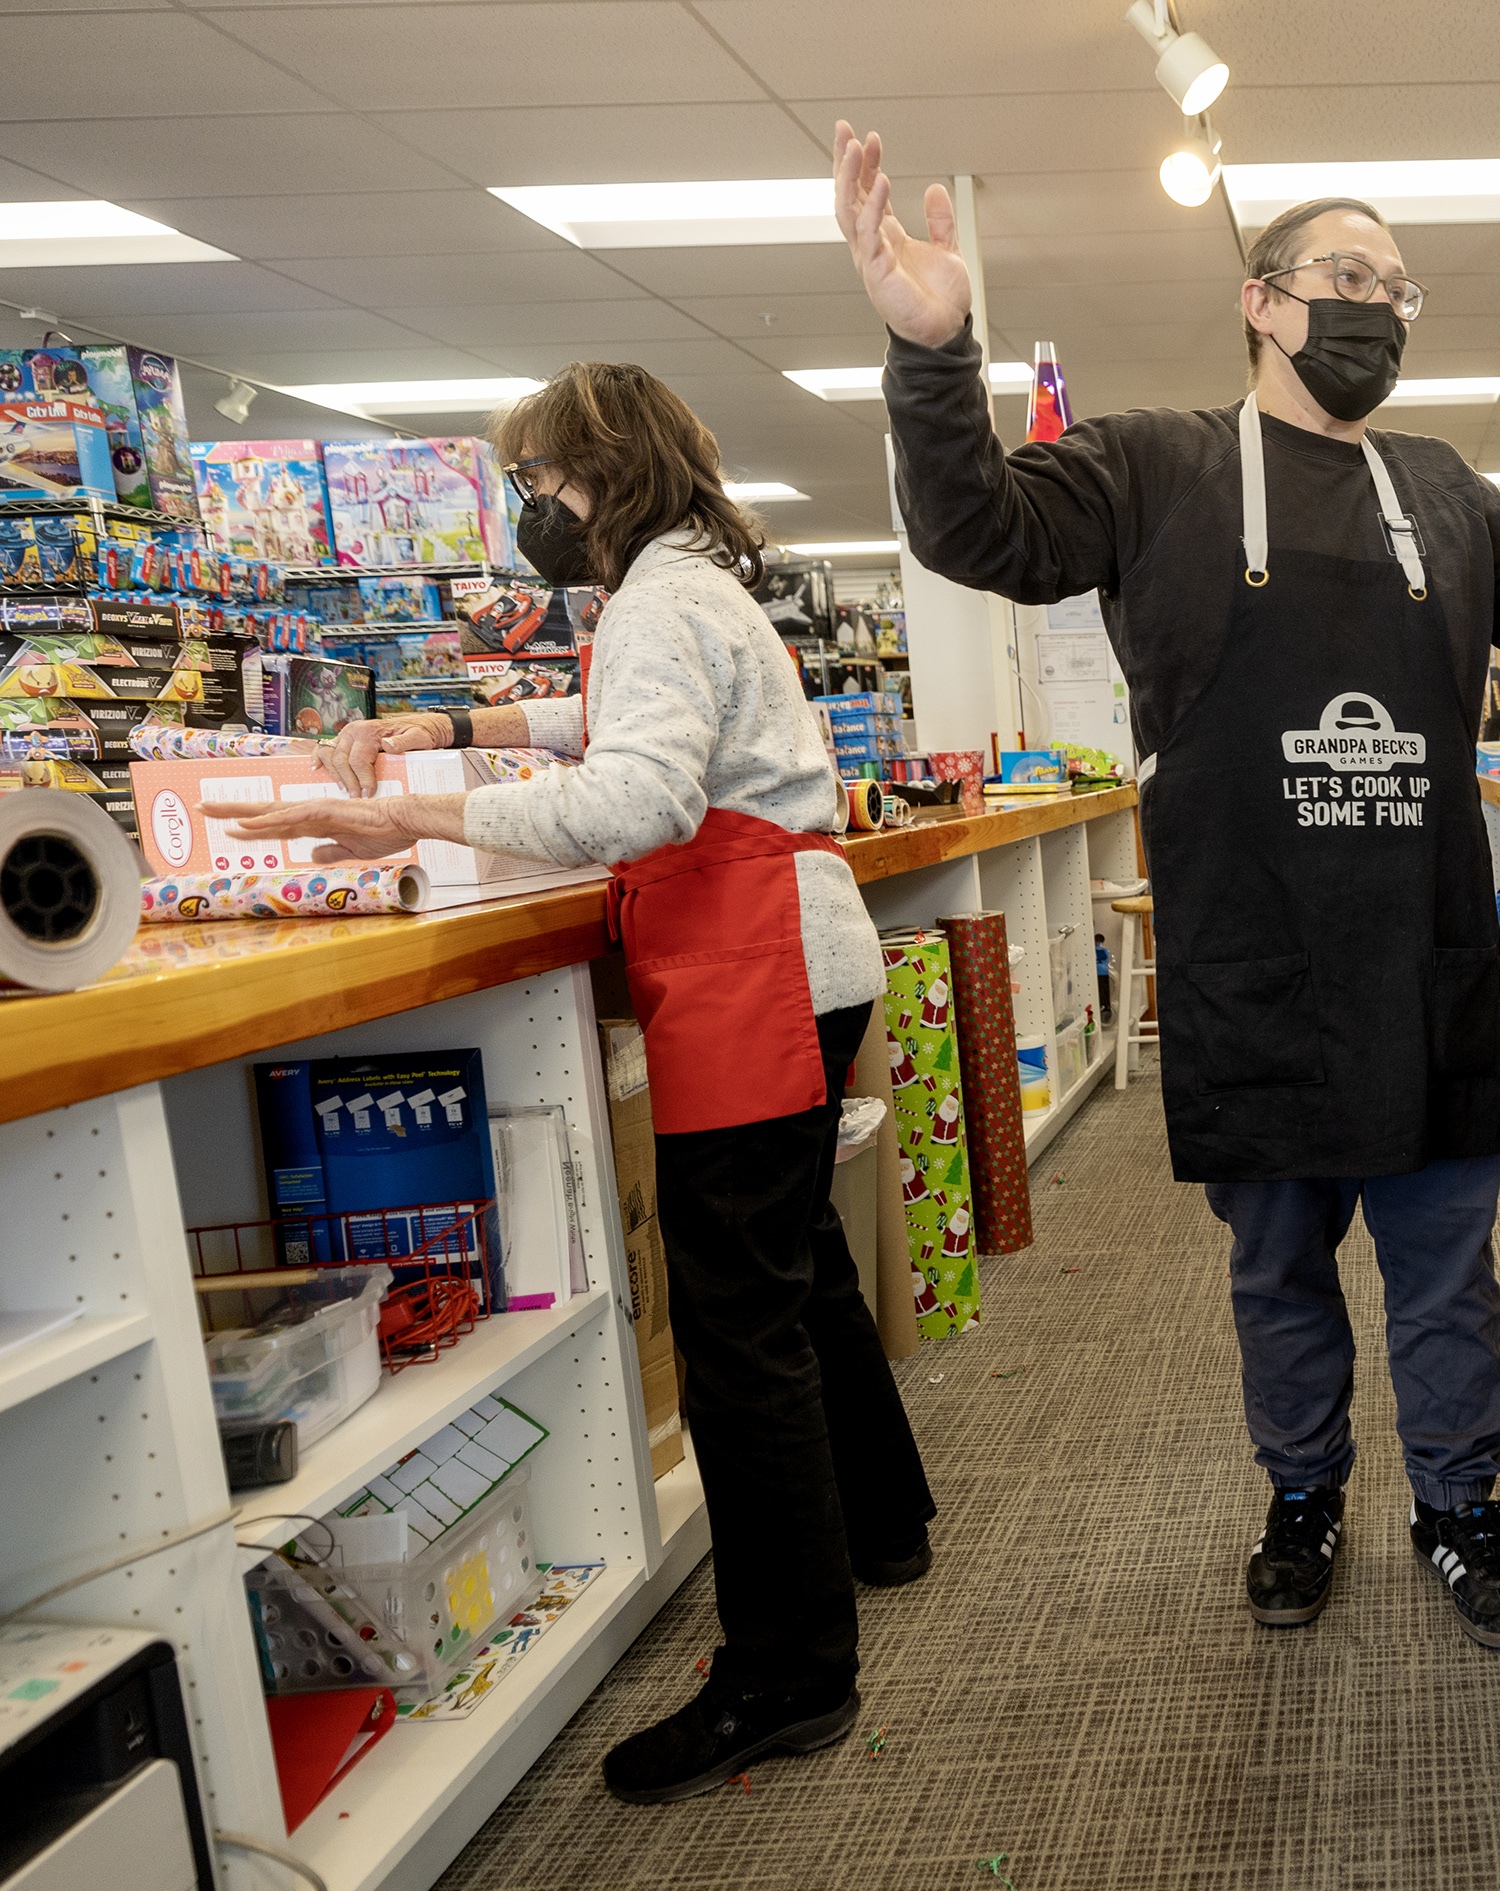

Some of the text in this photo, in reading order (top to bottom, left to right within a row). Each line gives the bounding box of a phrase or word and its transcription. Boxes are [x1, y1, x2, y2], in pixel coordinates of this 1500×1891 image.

[453, 581, 486, 591] TAIYO
[102, 613, 128, 623] DEOXYS
[131, 646, 163, 658] VIRIZION
[470, 664, 505, 674] TAIYO
[112, 678, 149, 688] ELECTRODE
[90, 709, 127, 720] VIRIZION
[1294, 738, 1419, 756] GRANDPA BECK'S
[1340, 757, 1383, 765] GAMES
[1282, 776, 1431, 799] LET'S COOK UP
[1296, 801, 1423, 827] SOME FUN!
[160, 797, 185, 861] Corolle
[269, 1069, 300, 1079] AVERY
[362, 1074, 382, 1082] Labels
[396, 1072, 411, 1082] Easy
[428, 1069, 461, 1079] Technology
[628, 1250, 642, 1321] encore
